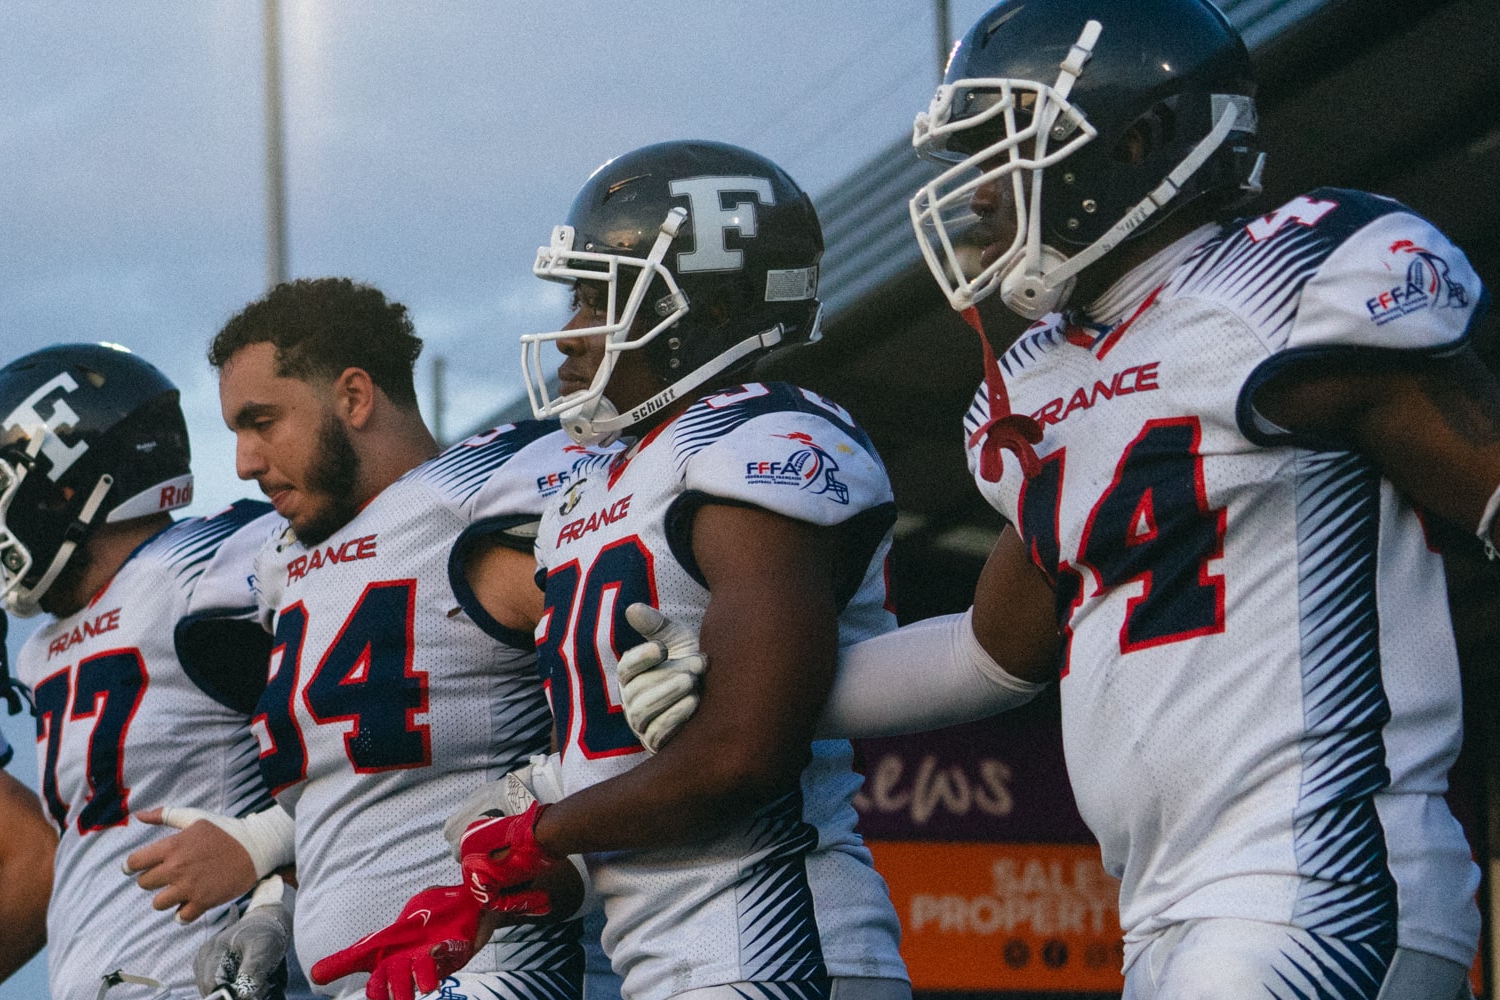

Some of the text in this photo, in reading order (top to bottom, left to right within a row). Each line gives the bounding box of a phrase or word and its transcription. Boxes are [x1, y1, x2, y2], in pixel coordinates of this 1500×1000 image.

[668, 175, 775, 274] F
[1366, 283, 1425, 314] FFFA
[2, 371, 90, 483] F
[536, 470, 571, 490] FFF
[746, 461, 800, 476] FFFA
[556, 493, 634, 549] FRANCE
[286, 533, 378, 587] FRANCE
[47, 607, 122, 661] FRANCE
[34, 646, 150, 838] 77
[993, 858, 1116, 898] SALE
[910, 892, 1116, 936] PROPERT
